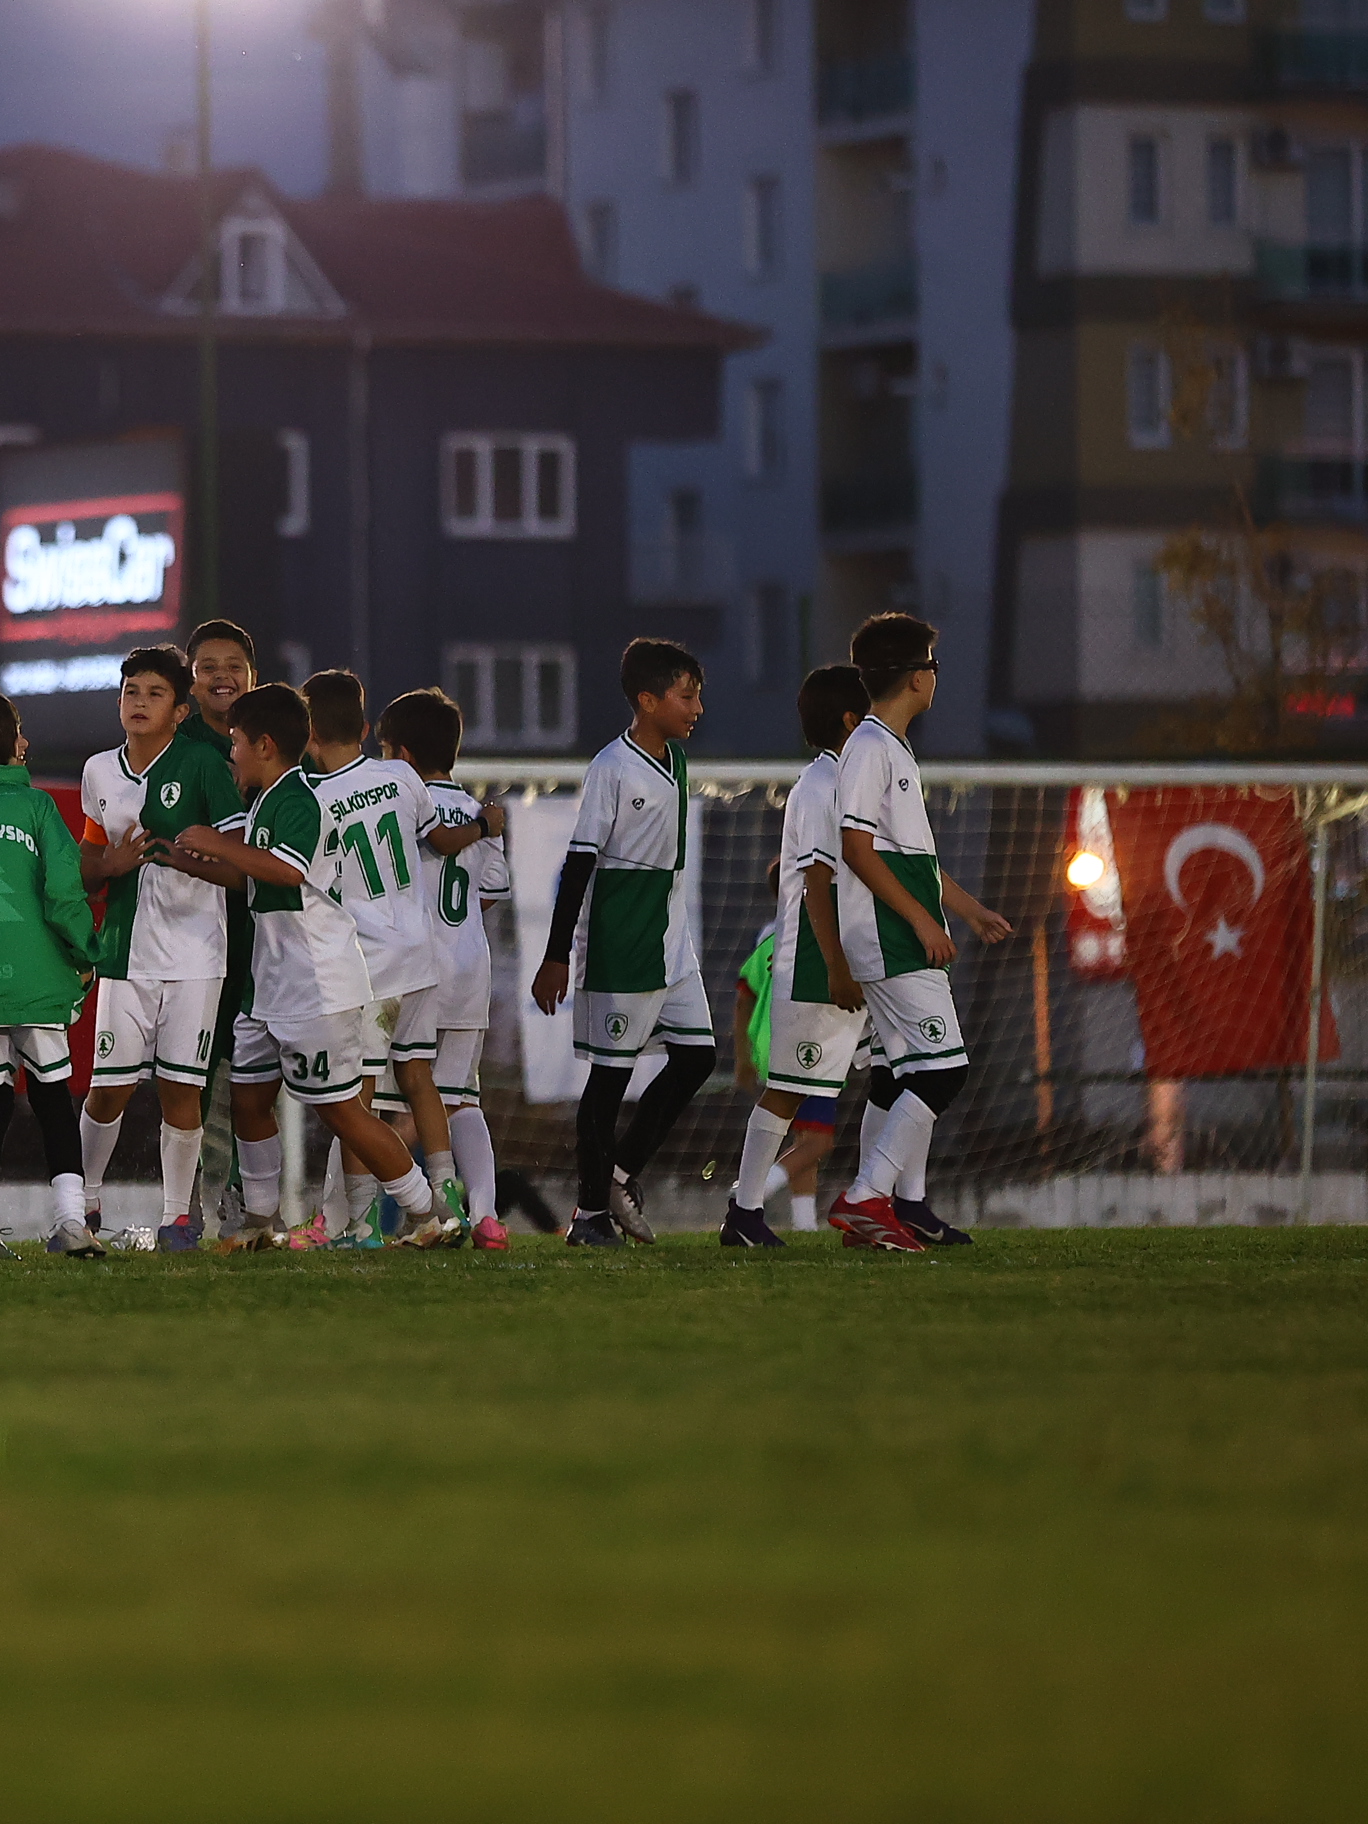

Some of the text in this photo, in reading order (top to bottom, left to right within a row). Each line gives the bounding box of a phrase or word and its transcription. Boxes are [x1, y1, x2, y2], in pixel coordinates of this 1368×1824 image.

[330, 782, 400, 823] ŞİLKÖYSPOR
[340, 811, 411, 901] 11
[438, 854, 469, 928] 6
[196, 1029, 211, 1062] 10
[292, 1050, 330, 1082] 34
